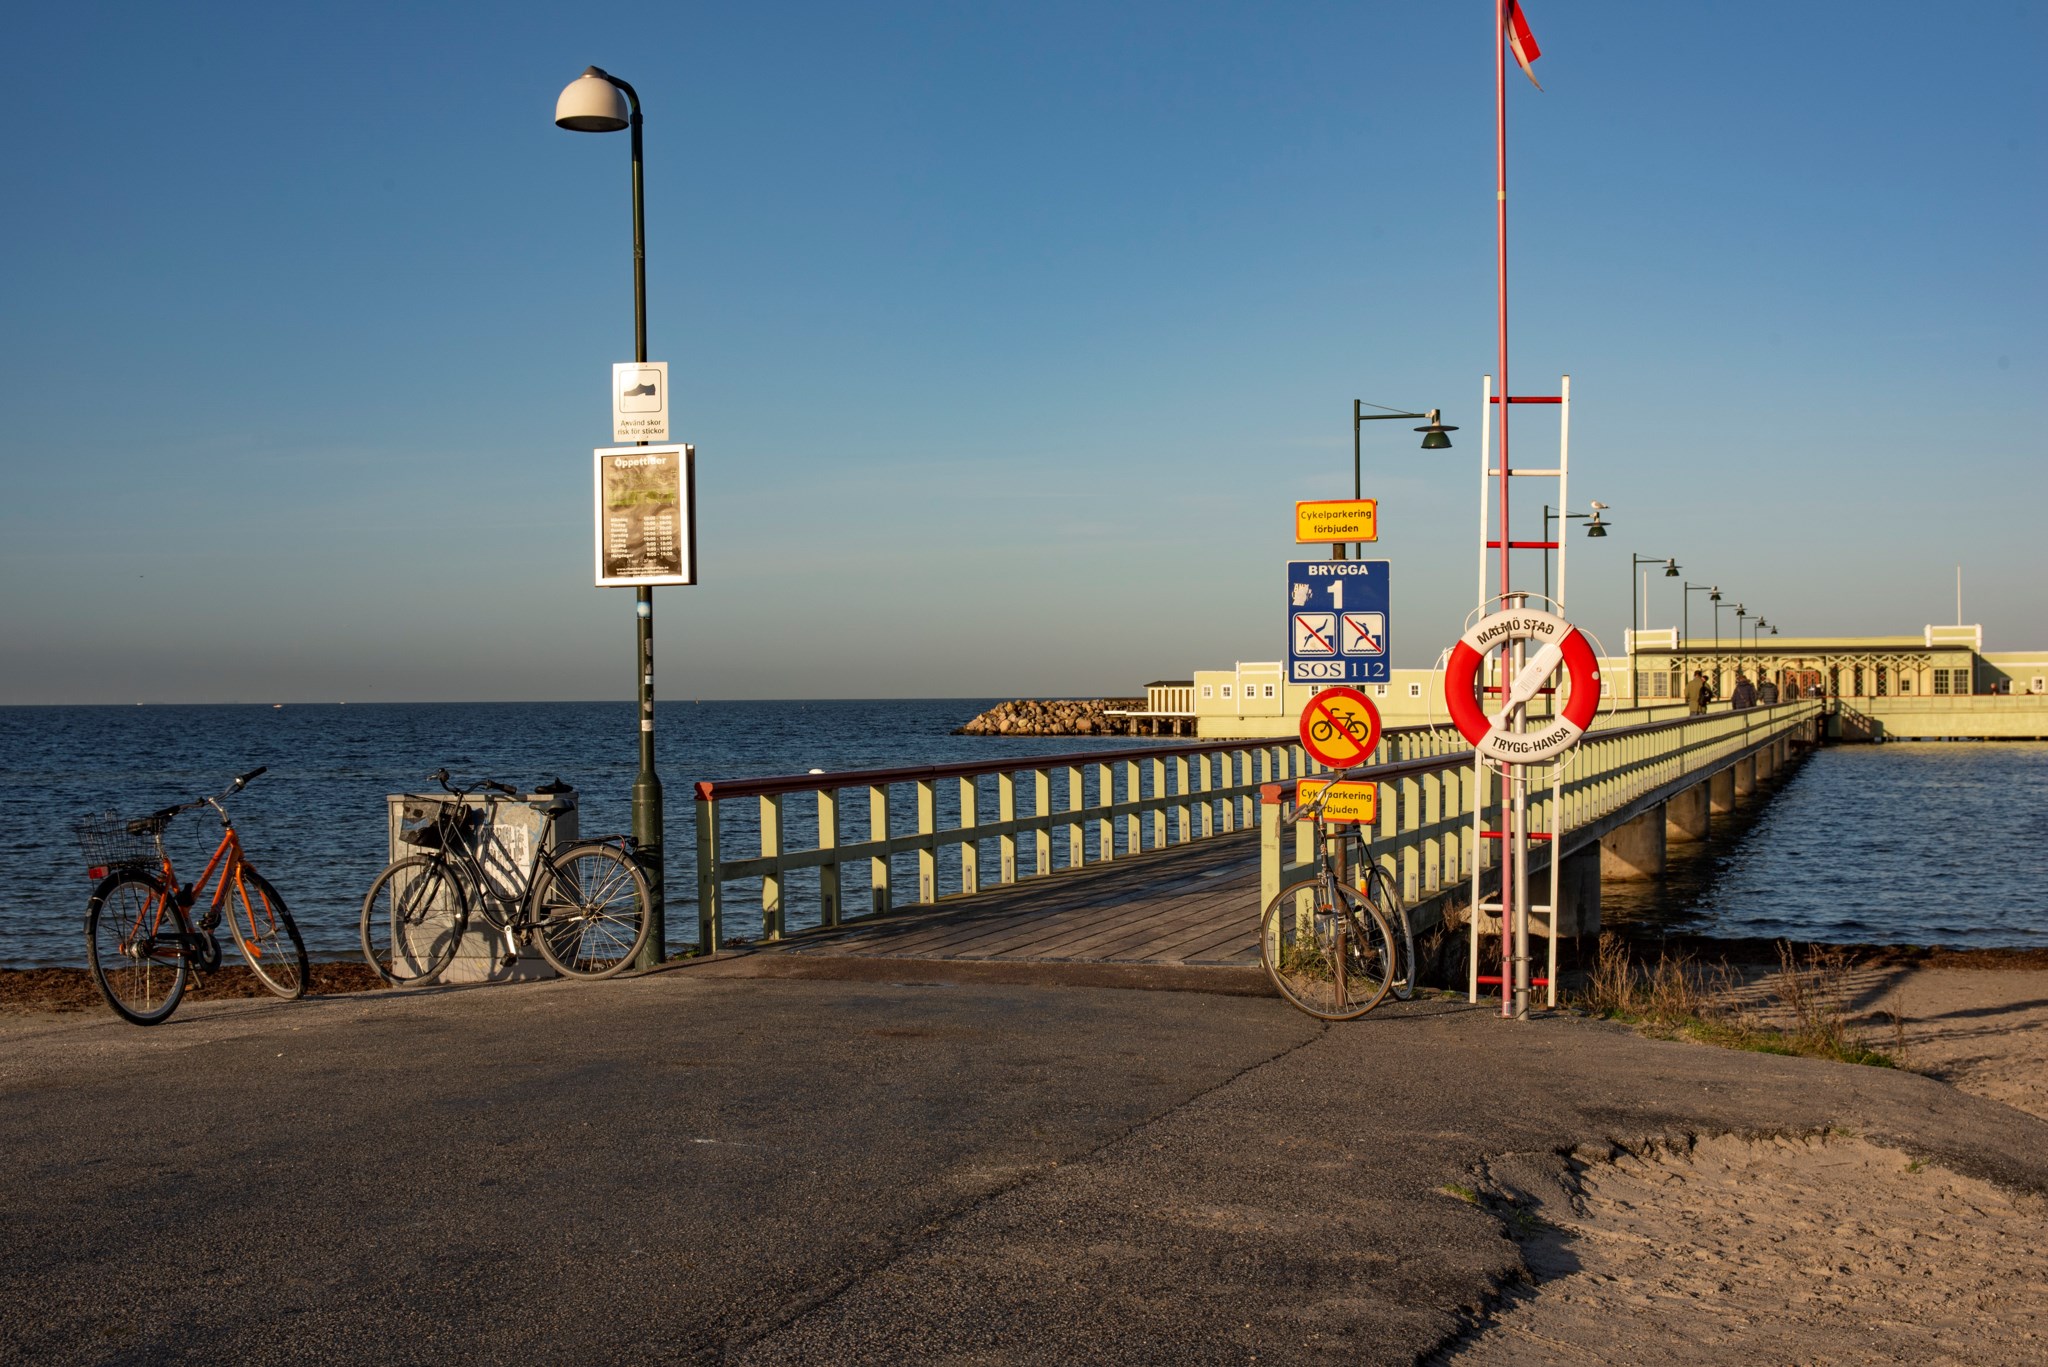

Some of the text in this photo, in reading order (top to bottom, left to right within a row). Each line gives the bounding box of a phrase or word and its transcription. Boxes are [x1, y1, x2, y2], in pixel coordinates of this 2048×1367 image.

[614, 456, 666, 468] Öppettider
[1301, 509, 1372, 520] Cykelparkering
[1314, 524, 1358, 534] förbjuden
[1308, 564, 1368, 576] BRYGGA
[1326, 580, 1343, 609] 1
[1477, 617, 1554, 645] MALMÖ STAD
[1297, 662, 1384, 677] SOS 112
[1492, 727, 1570, 753] TRYGG-HANSA
[1301, 789, 1372, 802] Cyklparkering
[1322, 806, 1358, 814] rbjuden
